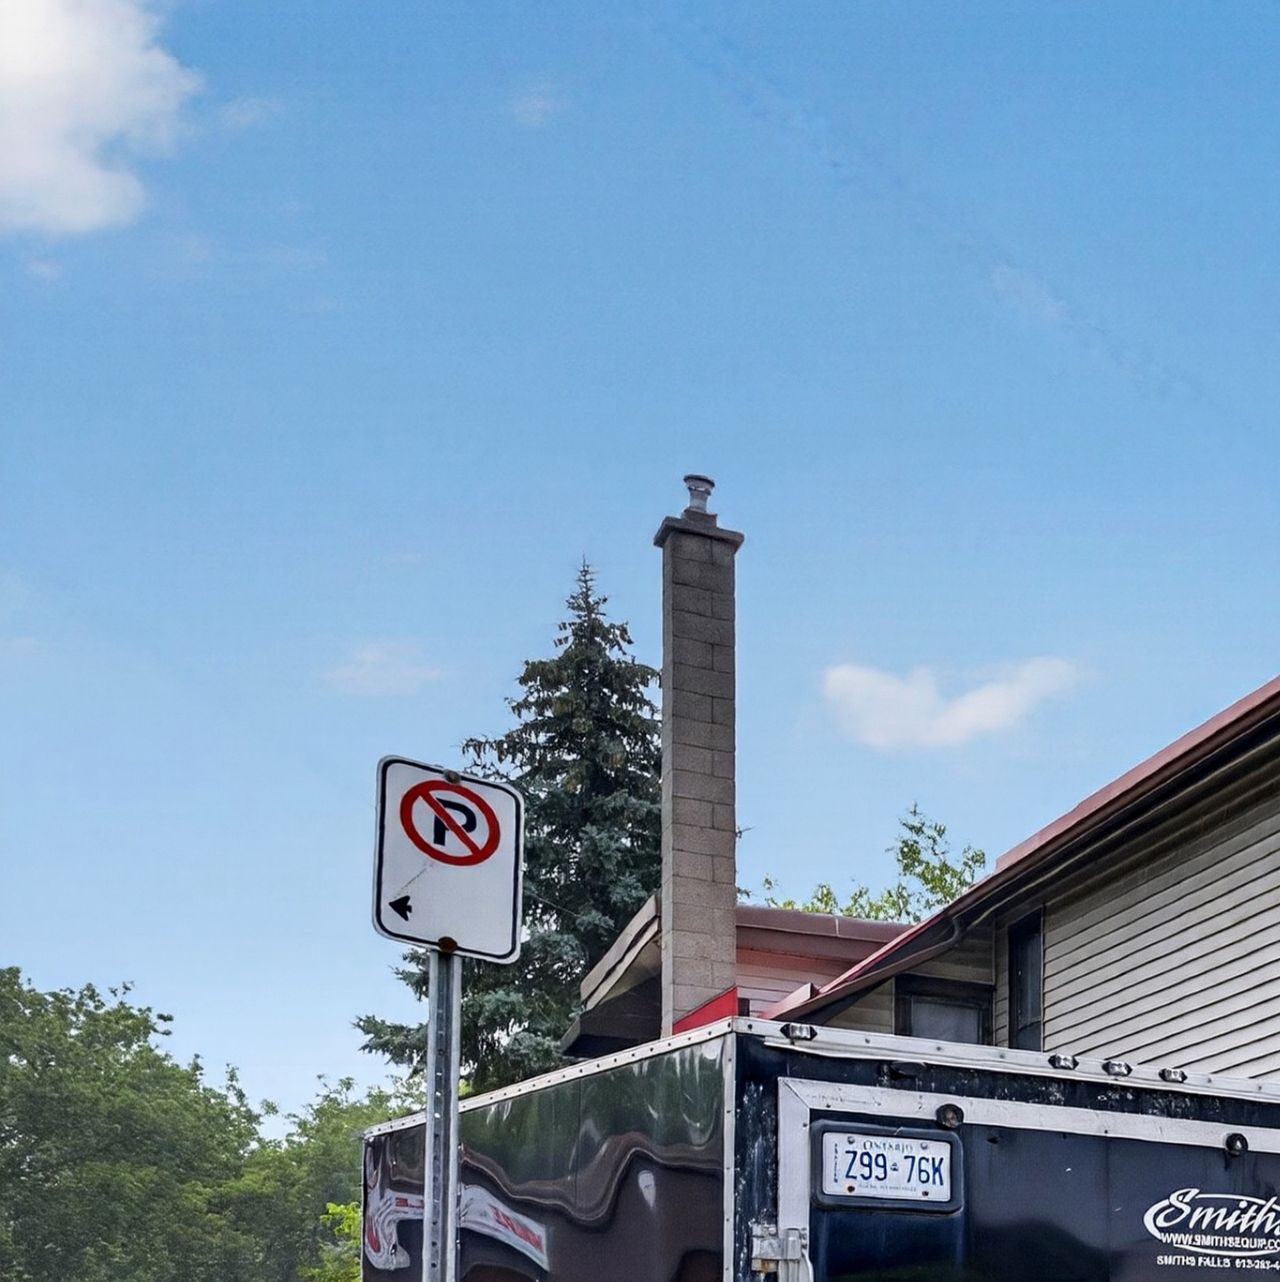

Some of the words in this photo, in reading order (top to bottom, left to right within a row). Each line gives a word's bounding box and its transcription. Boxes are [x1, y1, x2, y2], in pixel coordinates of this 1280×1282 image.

[433, 797, 477, 846] P
[845, 1150, 887, 1181] Z99
[904, 1155, 944, 1186] 76K
[1156, 1255, 1196, 1267] SMITHS
[1198, 1256, 1231, 1268] FALLS
